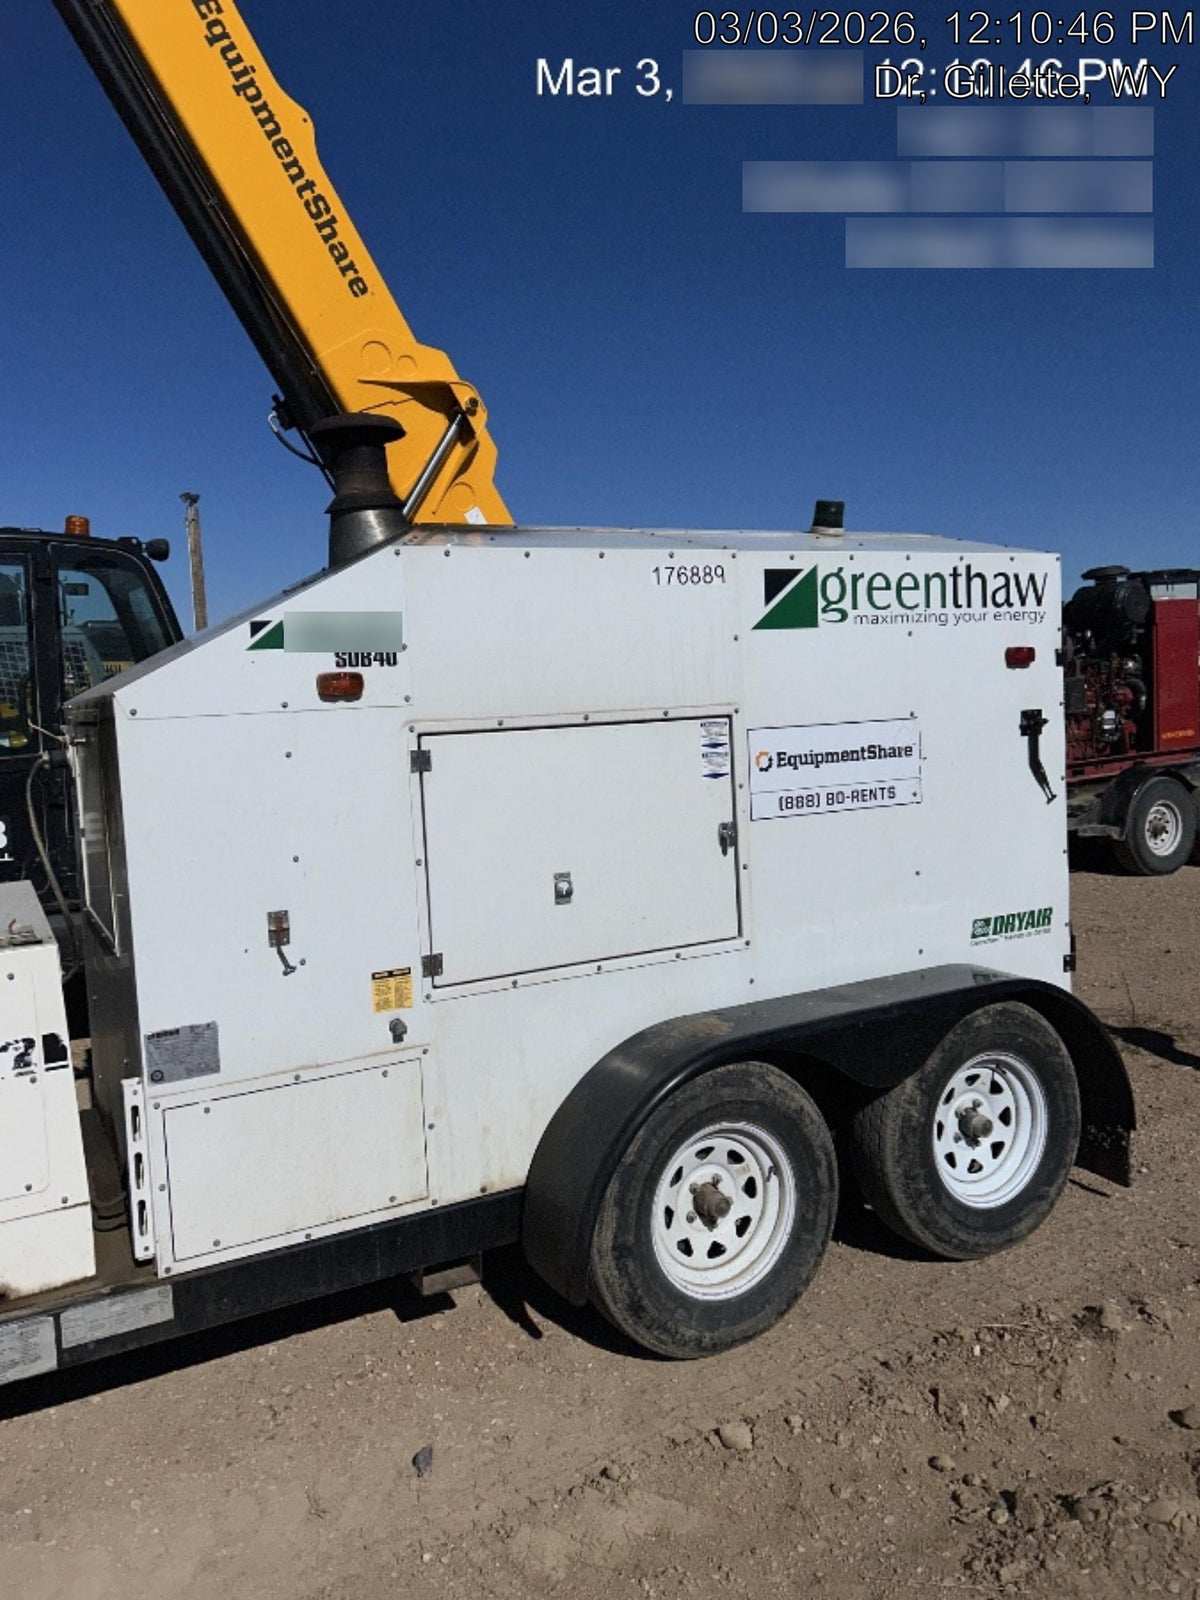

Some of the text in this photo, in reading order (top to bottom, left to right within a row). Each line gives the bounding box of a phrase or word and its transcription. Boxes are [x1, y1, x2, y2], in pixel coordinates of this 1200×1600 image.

[190, 0, 369, 298] EquipmentShare
[652, 564, 726, 586] 176889
[820, 564, 1048, 624] greenthaw
[853, 608, 1047, 627] maximizing your energy
[776, 744, 913, 770] EquipmentShare
[778, 792, 821, 811] (888)
[992, 906, 1053, 936] DRYAIR
